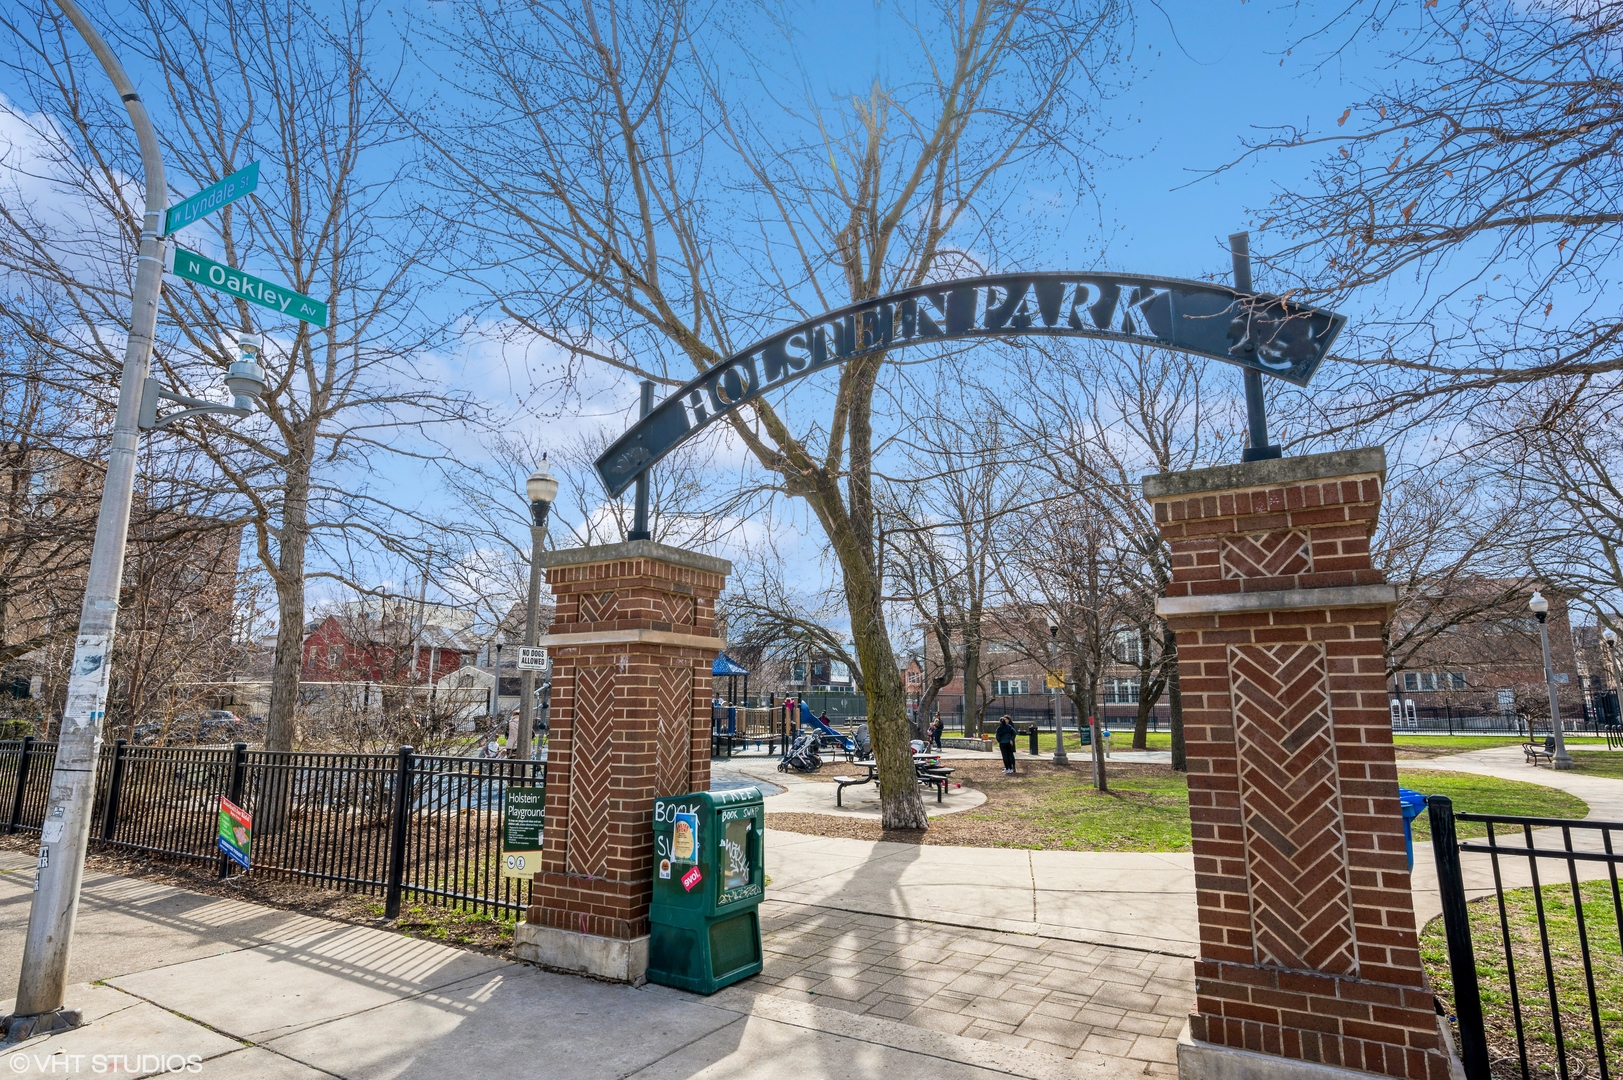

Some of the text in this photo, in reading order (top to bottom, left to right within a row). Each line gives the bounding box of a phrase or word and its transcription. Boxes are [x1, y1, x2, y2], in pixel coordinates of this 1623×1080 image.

[174, 175, 250, 223] W Lyndale St
[188, 260, 317, 317] N Oakley Av
[678, 282, 1172, 430] HOLSTEIN PARK
[521, 656, 545, 666] ALLOWED
[522, 649, 545, 658] NO DOGS
[508, 792, 538, 804] Holstein
[719, 789, 754, 804] FREE
[507, 805, 546, 820] Playground
[721, 806, 760, 823] BOOK SWAP
